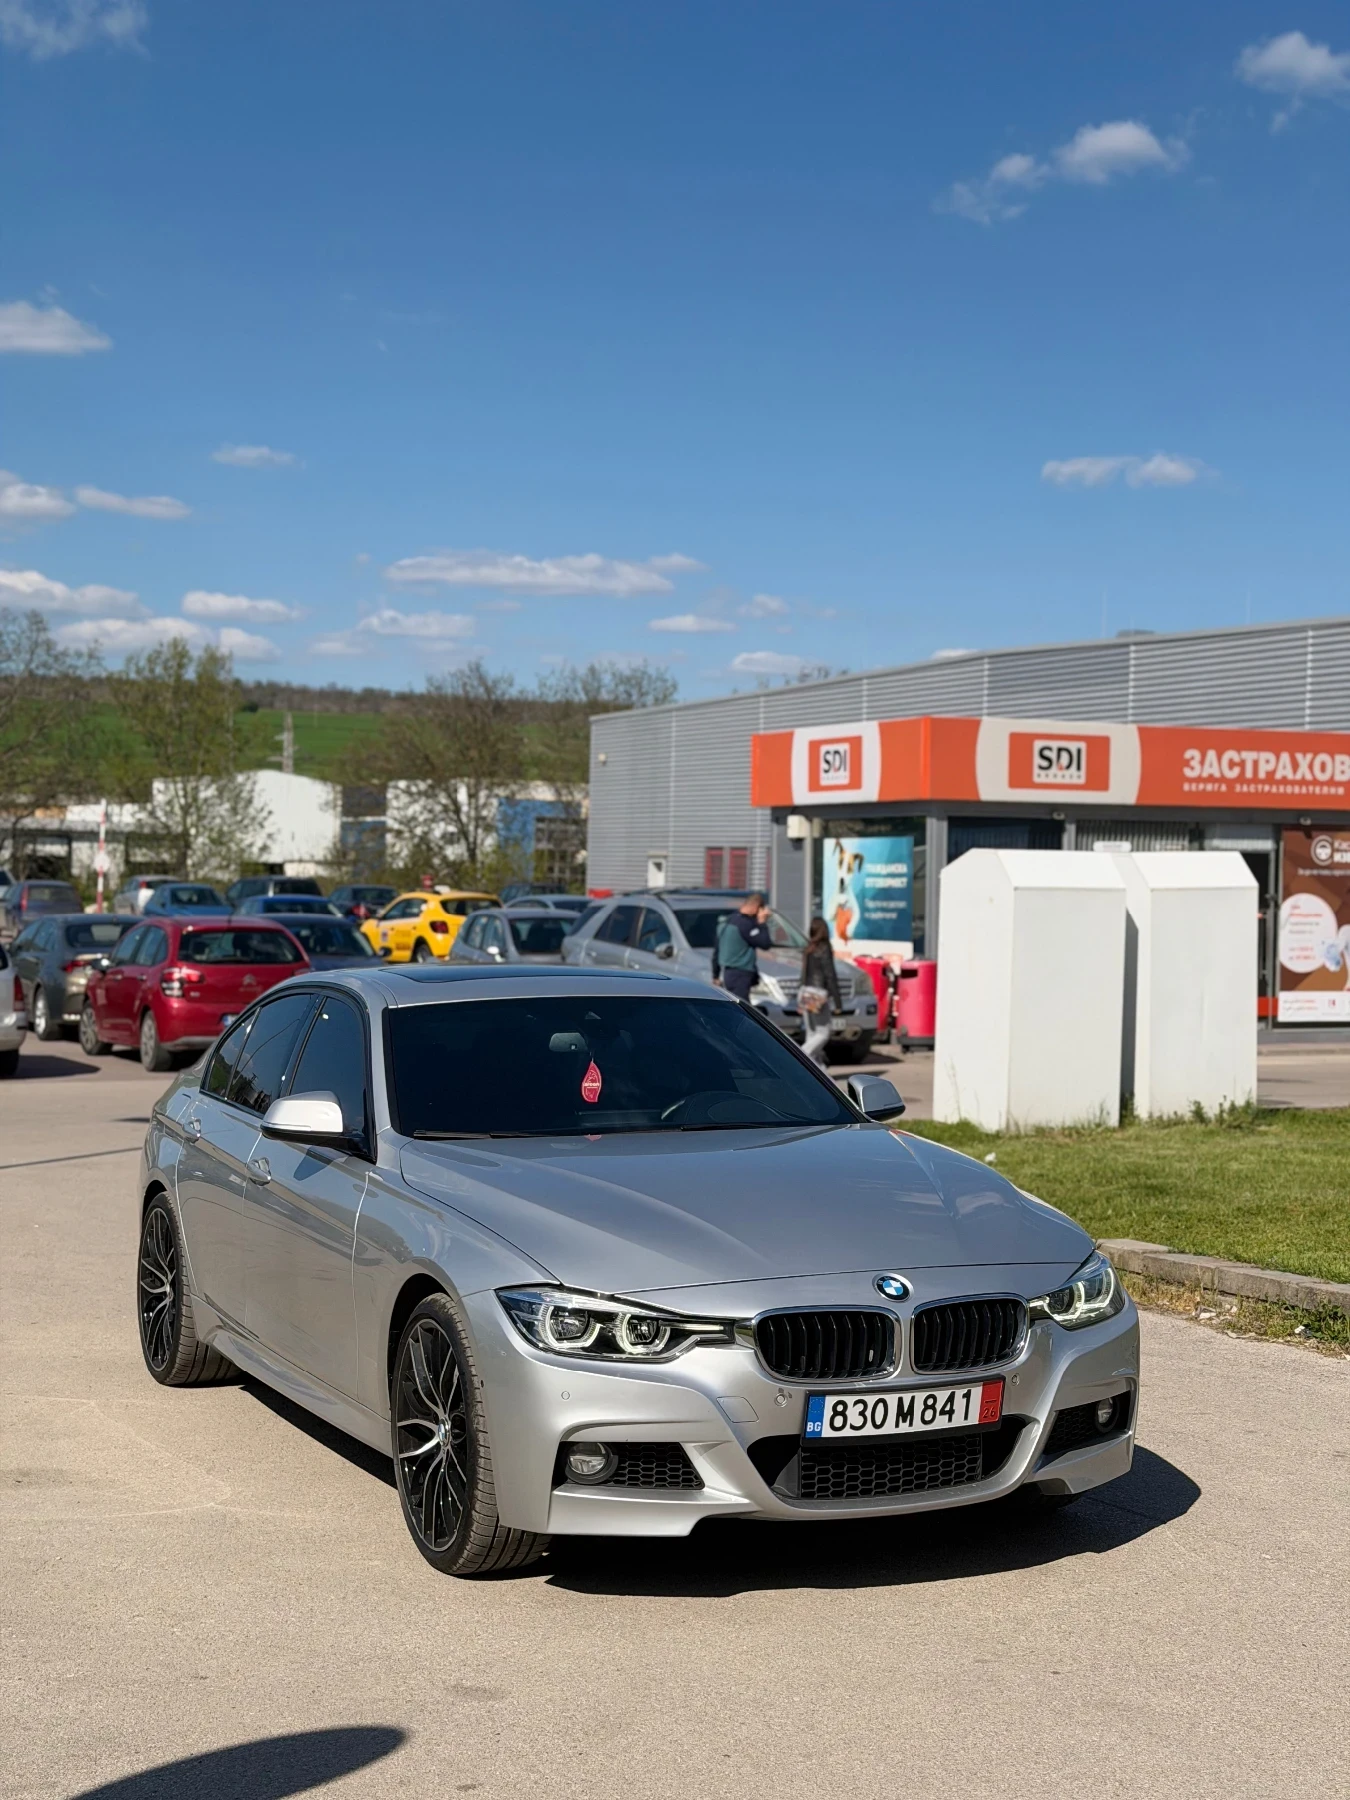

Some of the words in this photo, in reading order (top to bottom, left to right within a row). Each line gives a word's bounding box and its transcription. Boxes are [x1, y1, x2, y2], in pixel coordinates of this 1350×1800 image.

[823, 749, 848, 774] SDI
[1037, 745, 1082, 772] SDI
[1183, 748, 1350, 782] ЗАСТРАХОВ
[829, 1397, 889, 1432] 830
[895, 1395, 916, 1429] M
[920, 1388, 972, 1426] 841
[982, 1406, 997, 1420] 26
[806, 1421, 822, 1432] BG
